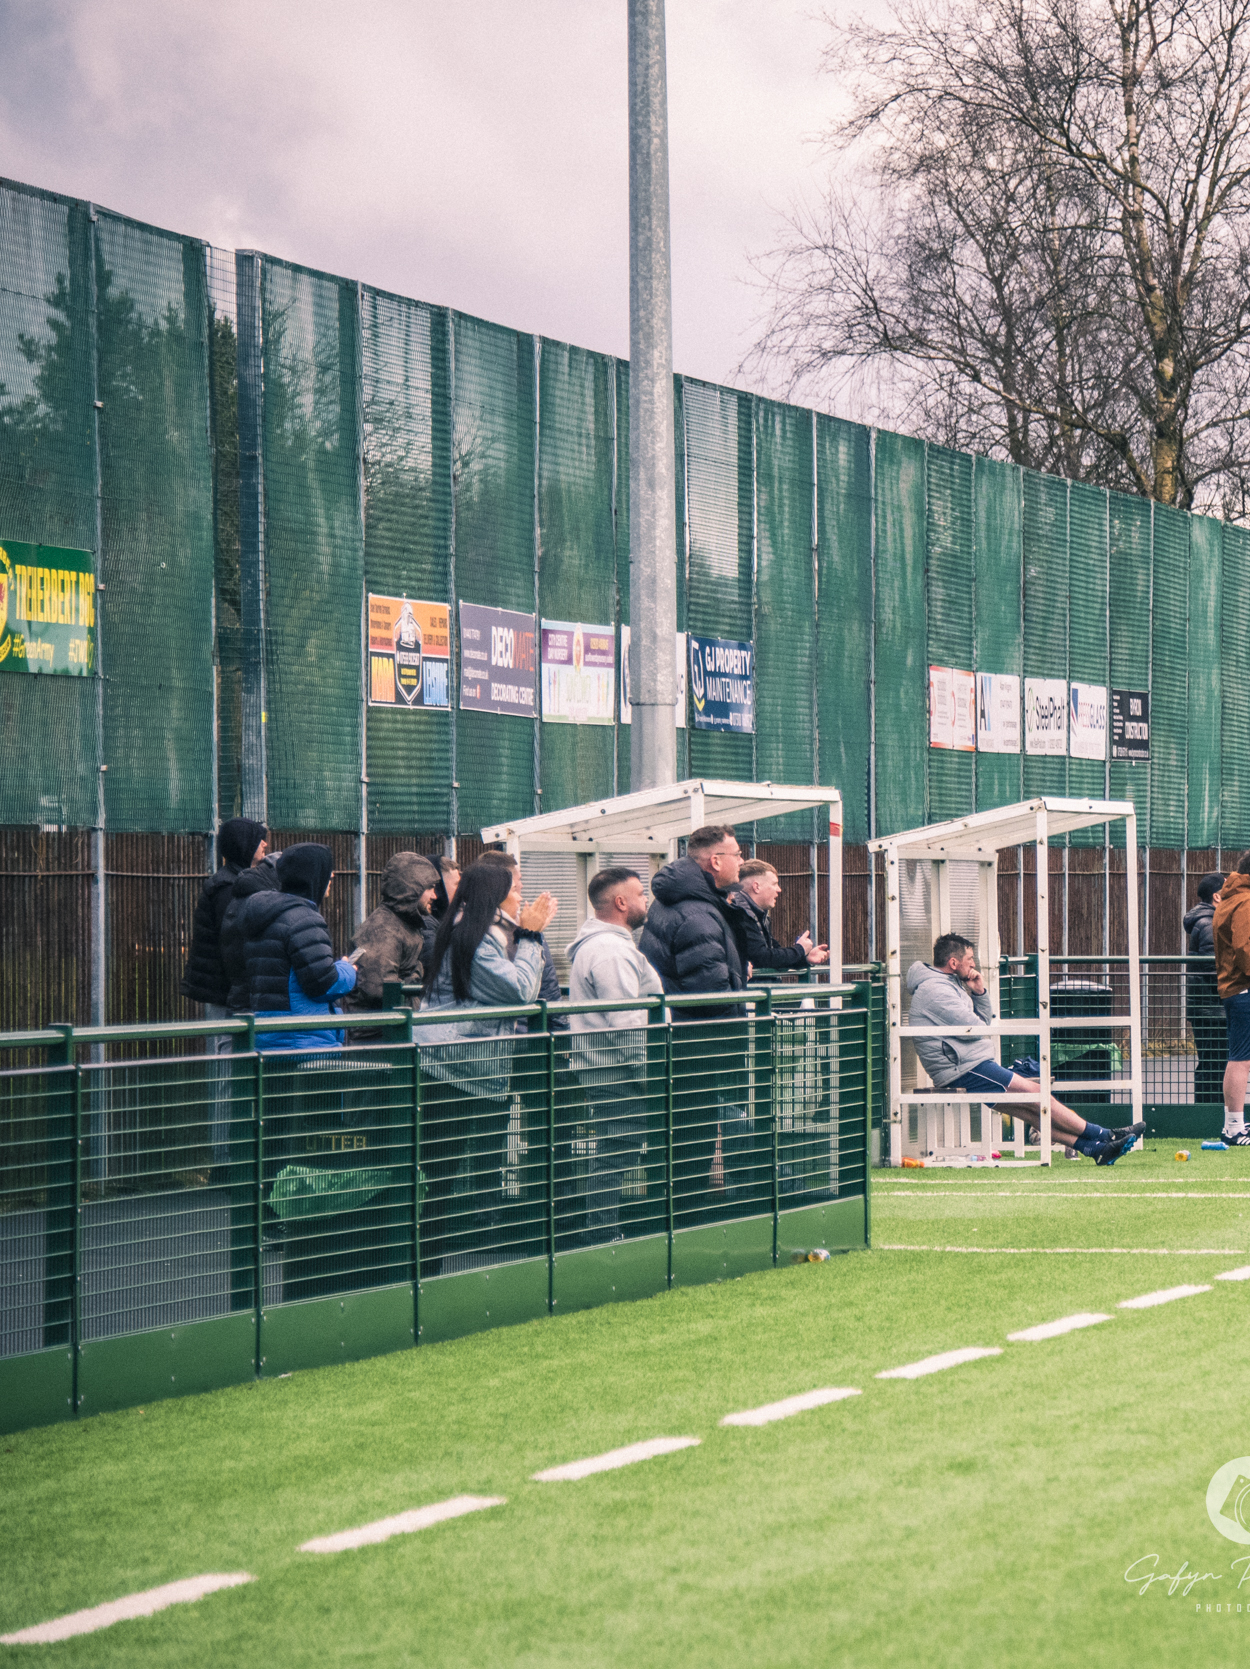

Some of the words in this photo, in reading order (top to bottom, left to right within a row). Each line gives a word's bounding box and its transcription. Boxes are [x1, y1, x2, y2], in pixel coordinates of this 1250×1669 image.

[15, 564, 77, 625] TREHERBERT
[79, 572, 95, 627] BGC
[705, 646, 715, 672] GJ
[716, 647, 751, 676] PROPERTY
[706, 676, 751, 705] MAINTENANCE
